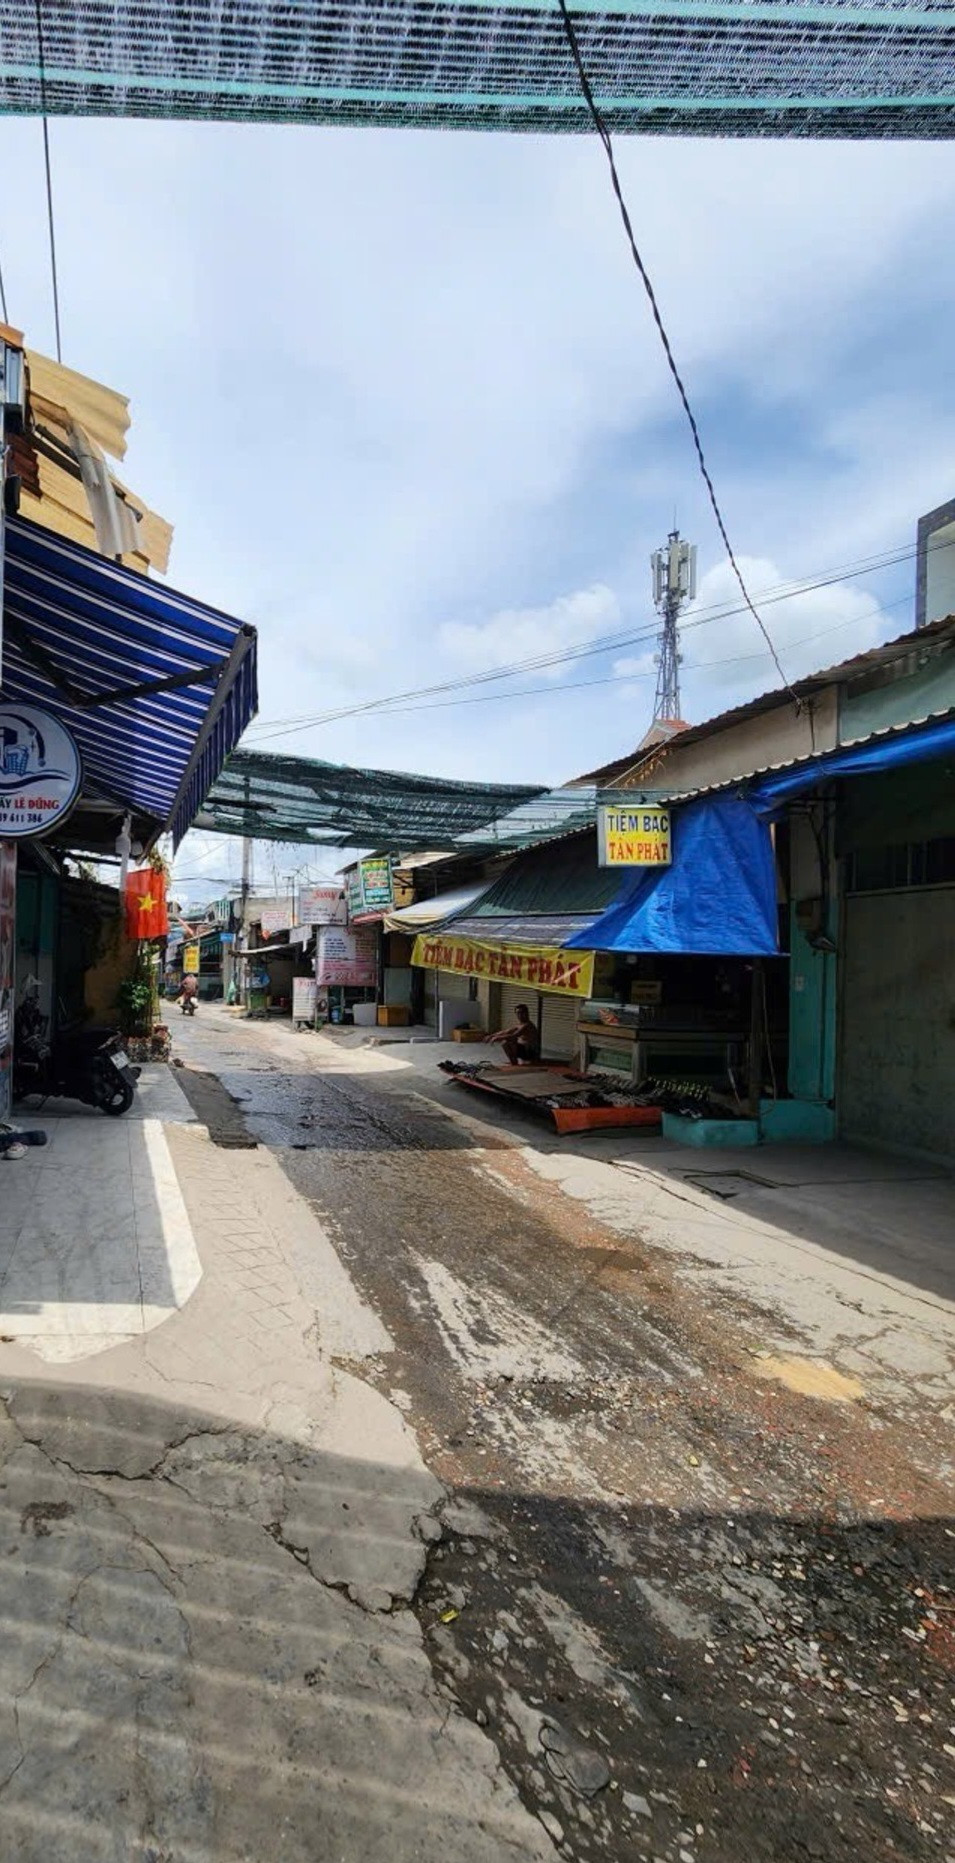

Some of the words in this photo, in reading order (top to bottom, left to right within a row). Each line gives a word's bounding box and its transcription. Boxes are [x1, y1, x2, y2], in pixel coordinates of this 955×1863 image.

[14, 797, 25, 809] LÊ
[607, 810, 638, 835] TIỆM
[643, 814, 669, 835] BẠC
[637, 838, 669, 861] PHÁT
[454, 948, 486, 974] BẠC
[527, 953, 582, 990] PHÁT
